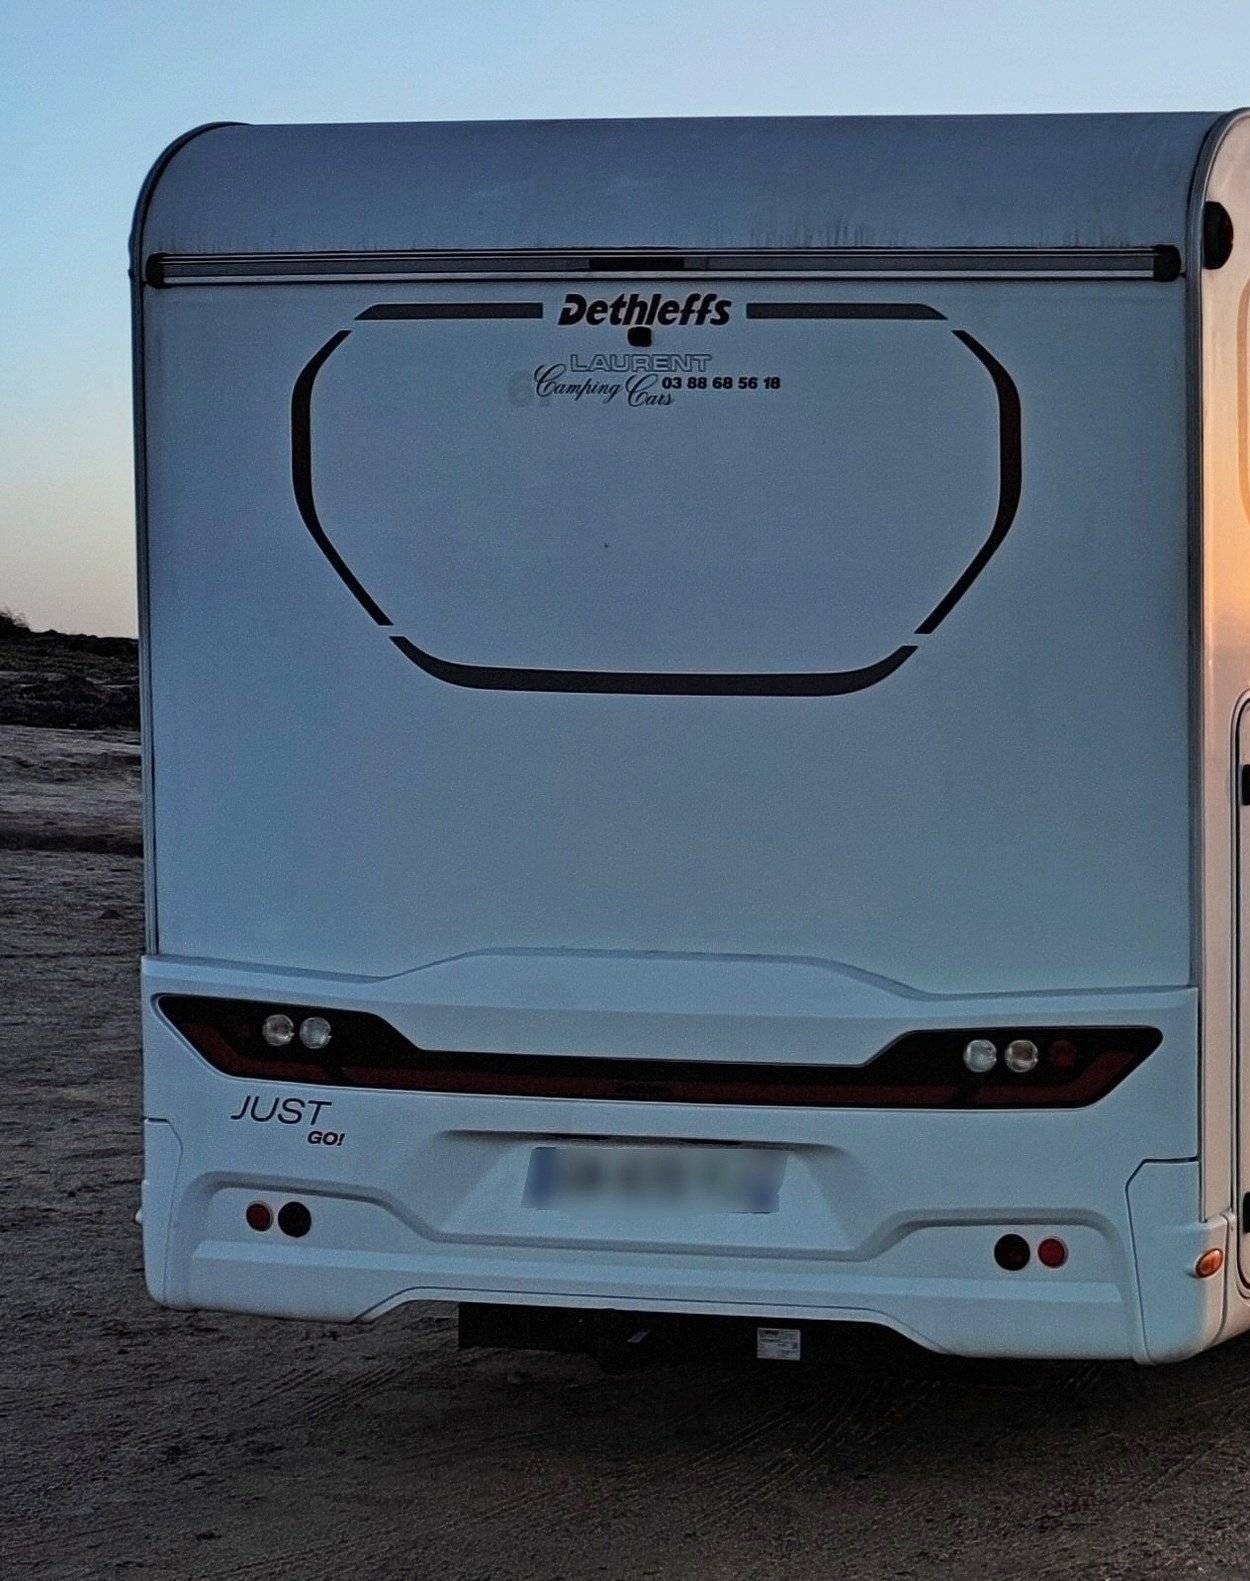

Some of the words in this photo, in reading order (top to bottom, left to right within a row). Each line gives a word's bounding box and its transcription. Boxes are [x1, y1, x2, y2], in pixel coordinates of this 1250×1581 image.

[558, 293, 731, 326] Dethleffs
[569, 353, 712, 373] LAURENT
[534, 363, 621, 404] Camping
[625, 373, 675, 408] Cars
[662, 376, 682, 390] 03
[687, 376, 707, 390] 88
[712, 376, 733, 390] 68
[738, 376, 759, 390] 56
[764, 376, 781, 390] 18
[230, 1095, 332, 1126] JUST
[307, 1130, 345, 1147] GO!
